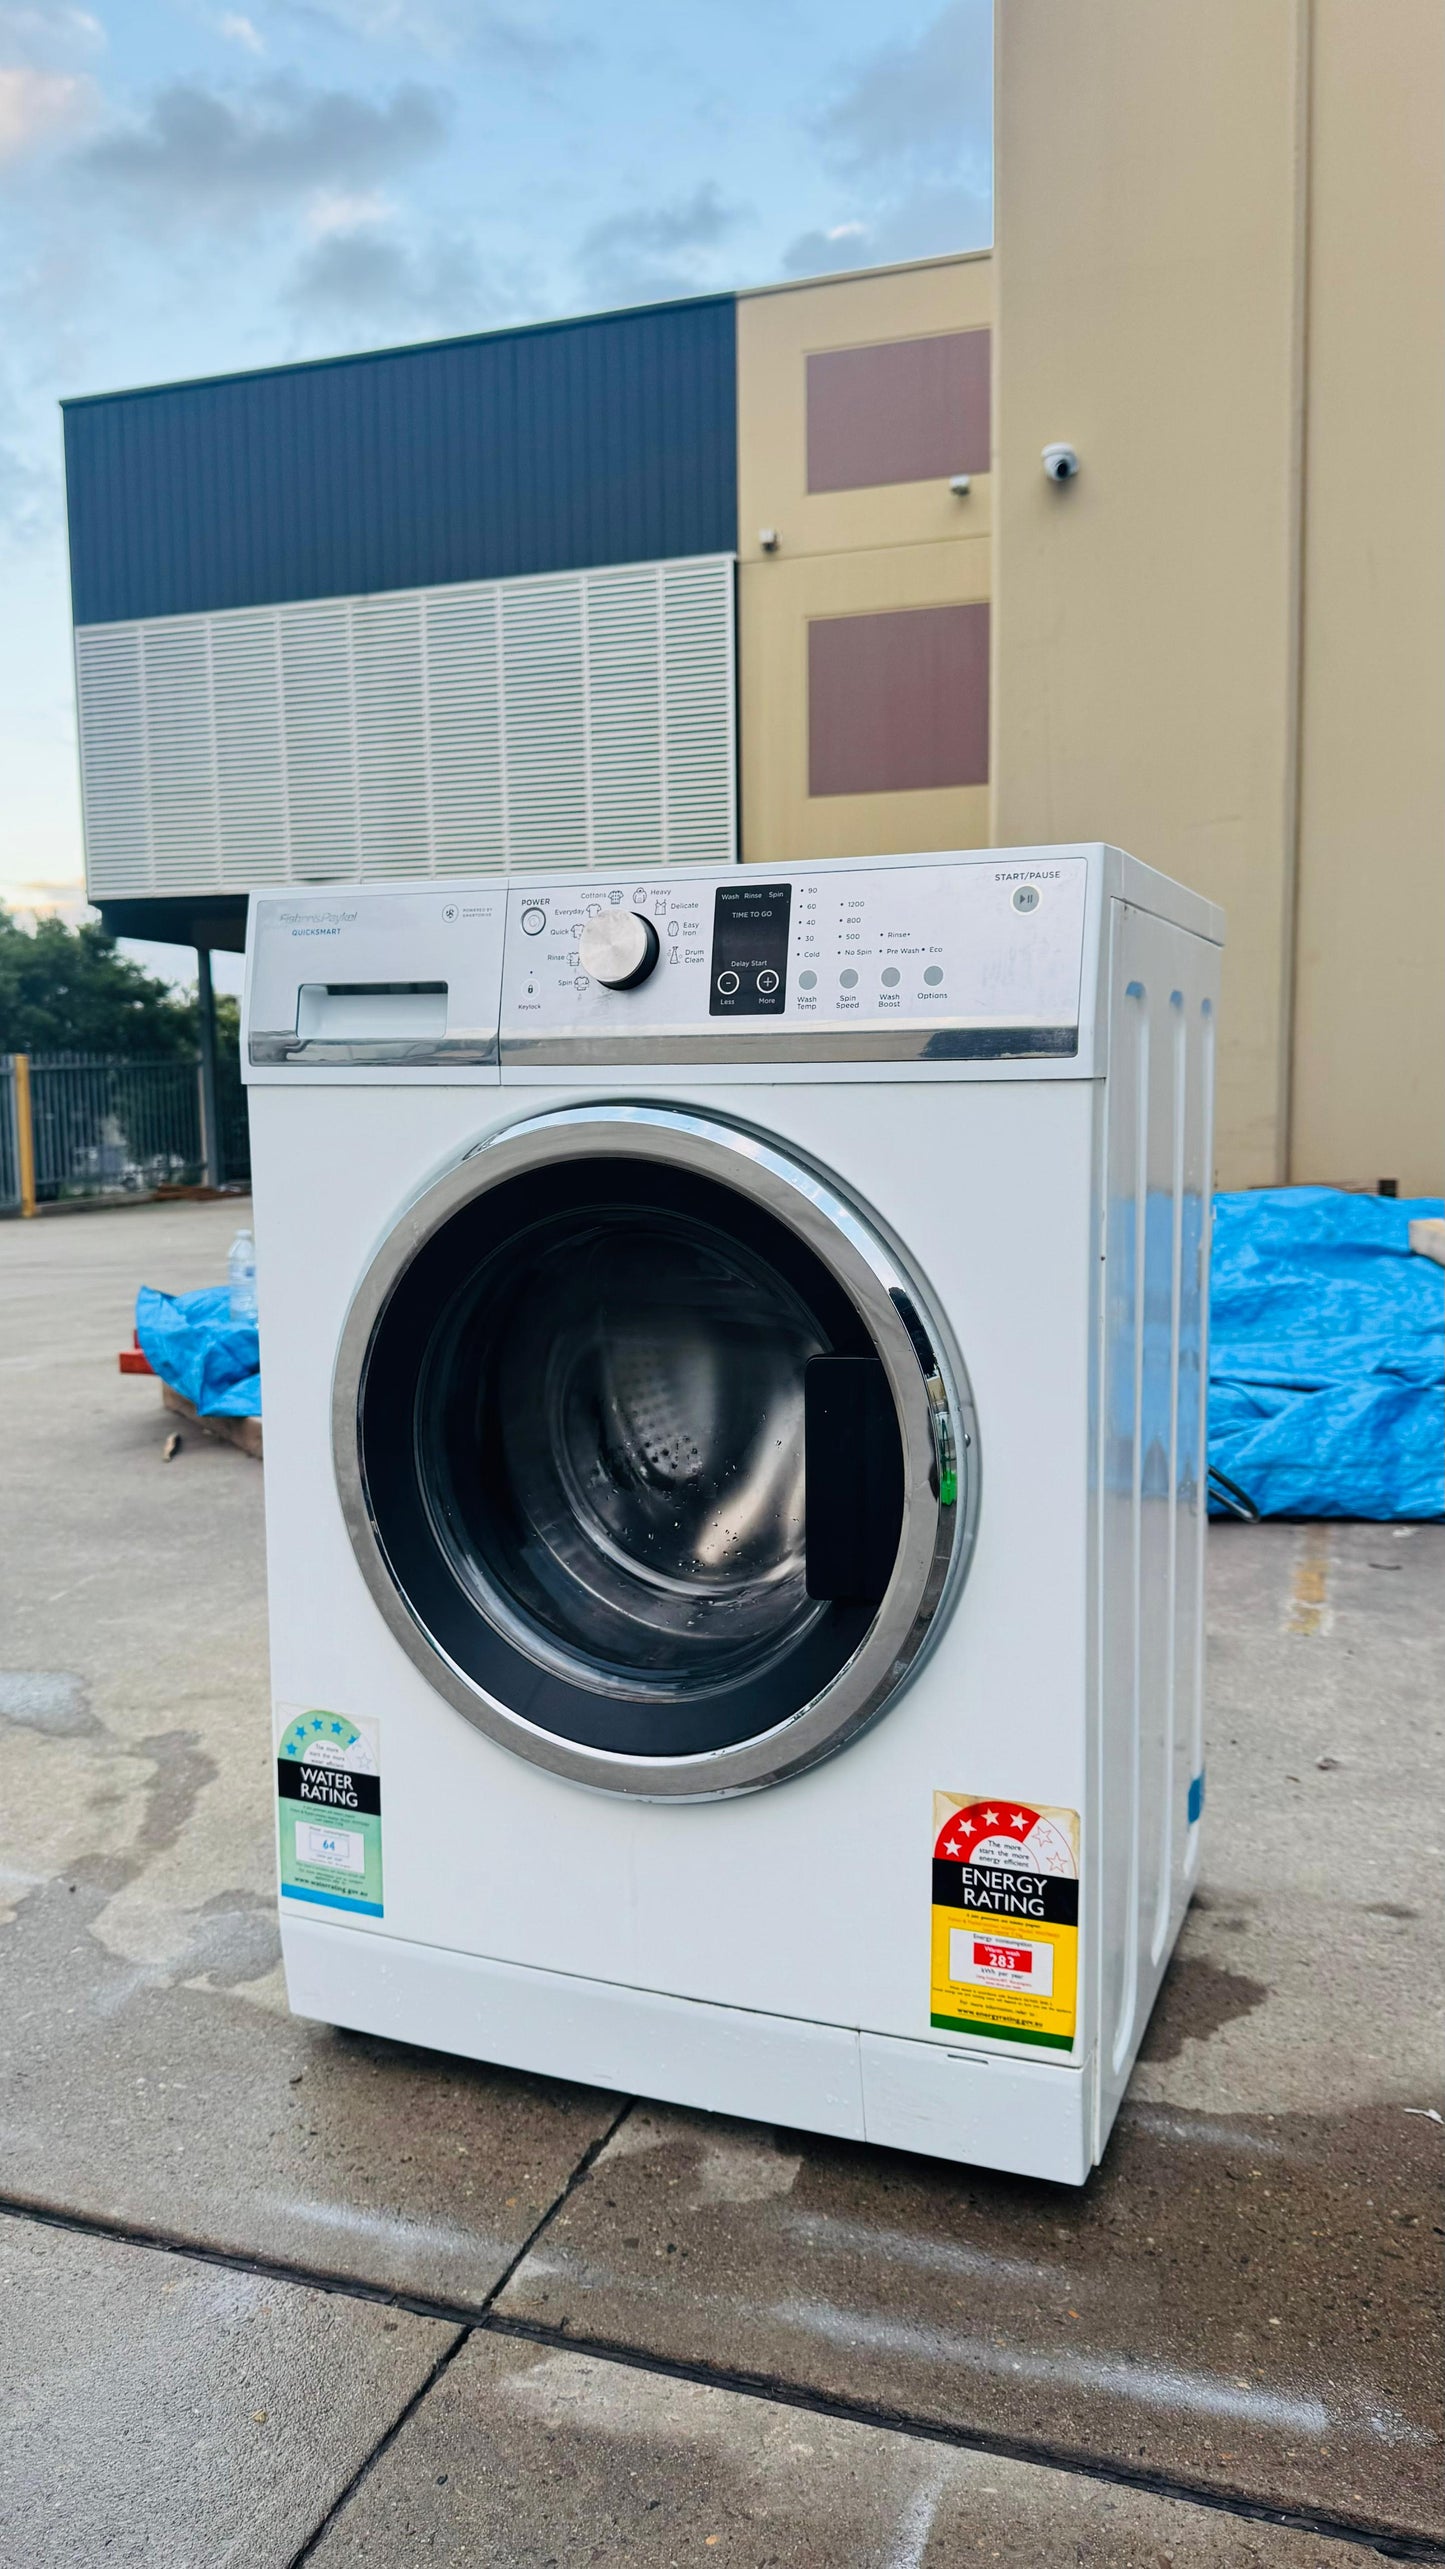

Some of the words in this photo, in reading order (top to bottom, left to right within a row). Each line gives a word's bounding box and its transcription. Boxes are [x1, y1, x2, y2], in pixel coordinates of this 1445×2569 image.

[995, 871, 1060, 880] START/PAUSE
[840, 994, 856, 1002] Spin
[836, 1002, 860, 1010] Speed
[300, 1766, 354, 1791] WATER
[300, 1782, 358, 1808] RATING
[322, 1840, 336, 1851] 64
[988, 1839, 1000, 1848] The
[979, 1856, 1000, 1864] energy
[1004, 1858, 1029, 1868] efficient
[962, 1867, 1048, 1896] ENERGY
[964, 1888, 1045, 1916] RATING
[972, 1932, 992, 1942] Energy
[995, 1938, 1033, 1948] consumption
[984, 1946, 1004, 1955] Warm
[1005, 1949, 1020, 1958] wash
[988, 1954, 1016, 1970] 283
